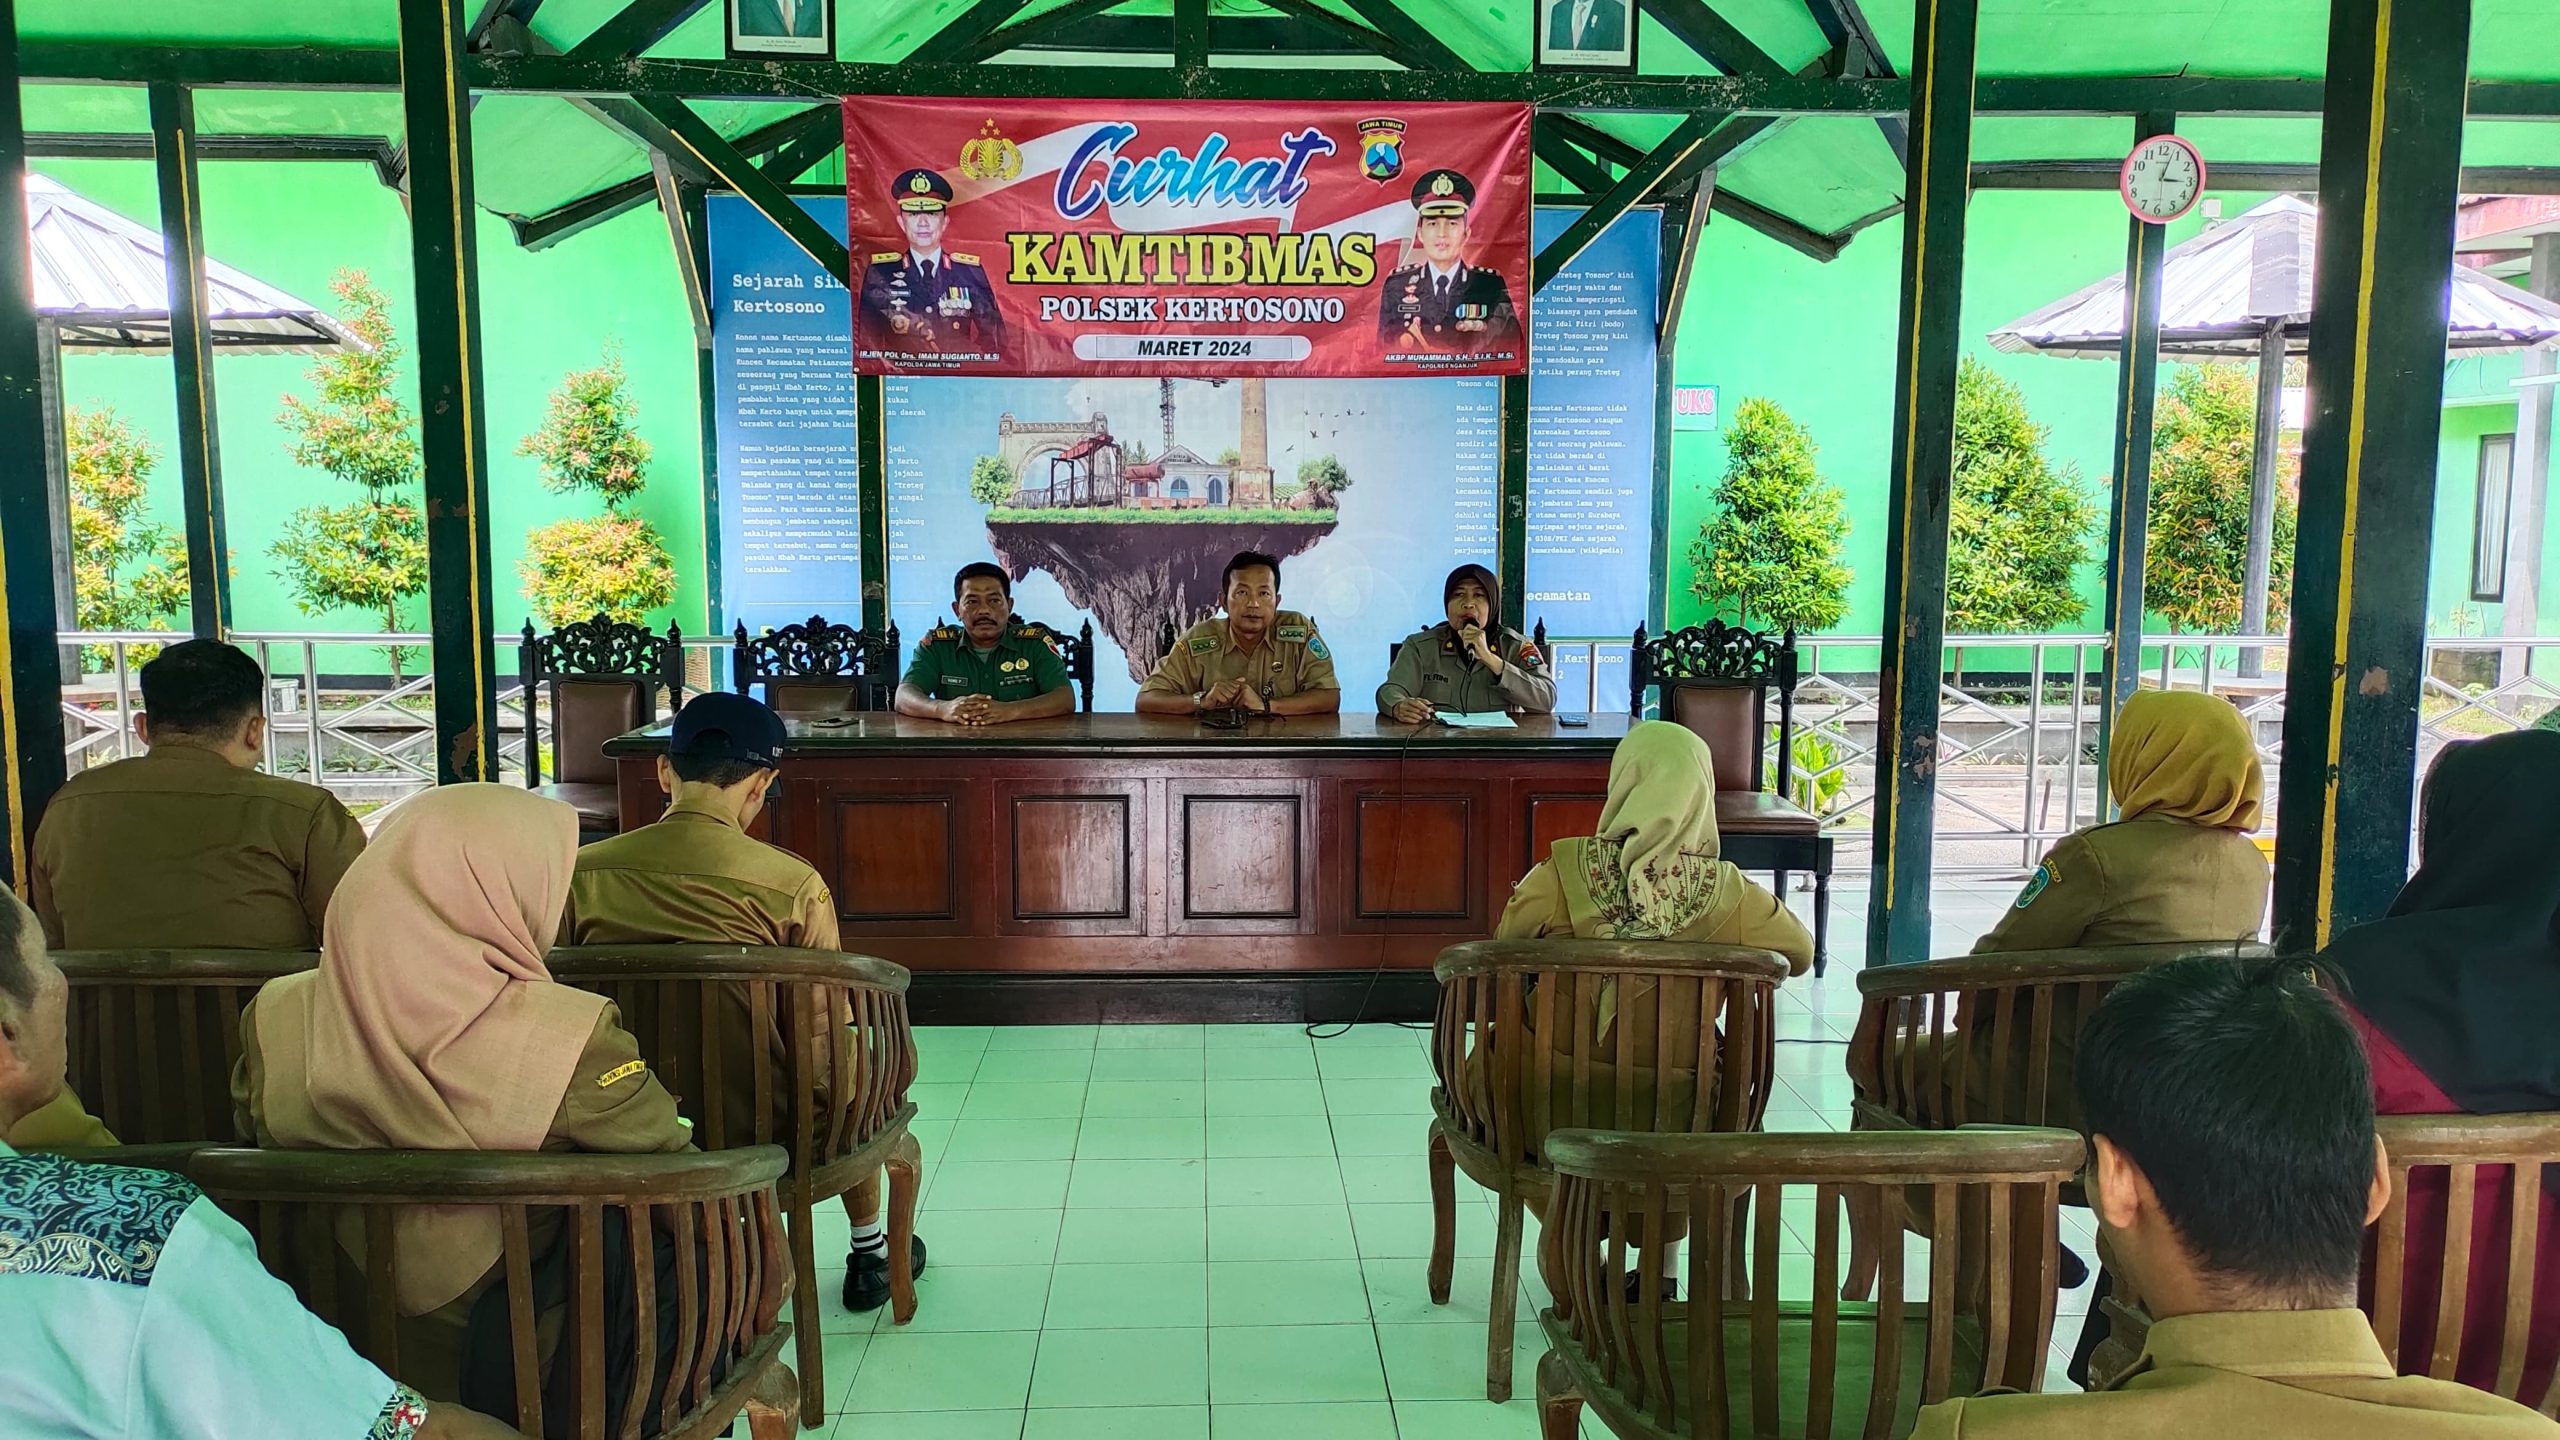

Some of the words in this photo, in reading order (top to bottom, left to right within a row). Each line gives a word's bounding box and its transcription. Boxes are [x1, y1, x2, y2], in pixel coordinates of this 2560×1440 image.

[2145, 150, 2153, 159] 11
[2159, 146, 2169, 156] 12
[2176, 151, 2179, 160] 1
[1056, 122, 1335, 218] Curhat
[2134, 161, 2145, 171] 10
[2184, 162, 2190, 171] 2
[2129, 174, 2135, 184] 9
[2186, 177, 2192, 187] 3
[2131, 188, 2137, 198] 8
[2180, 190, 2185, 200] 4
[2142, 200, 2147, 209] 7
[2154, 204, 2160, 215] 6
[2169, 201, 2175, 211] 5
[1007, 233, 1375, 284] KAMTIBMAS
[733, 274, 803, 290] Sejarah
[733, 300, 825, 313] Kertosono
[1041, 297, 1157, 322] POLSEK
[1164, 298, 1345, 322] KERTOSONO
[1138, 340, 1203, 356] MARET
[1208, 341, 1252, 356] 2024
[750, 384, 780, 392] panggil
[1676, 388, 1715, 414] UKS
[1527, 591, 1591, 600] ecamatan
